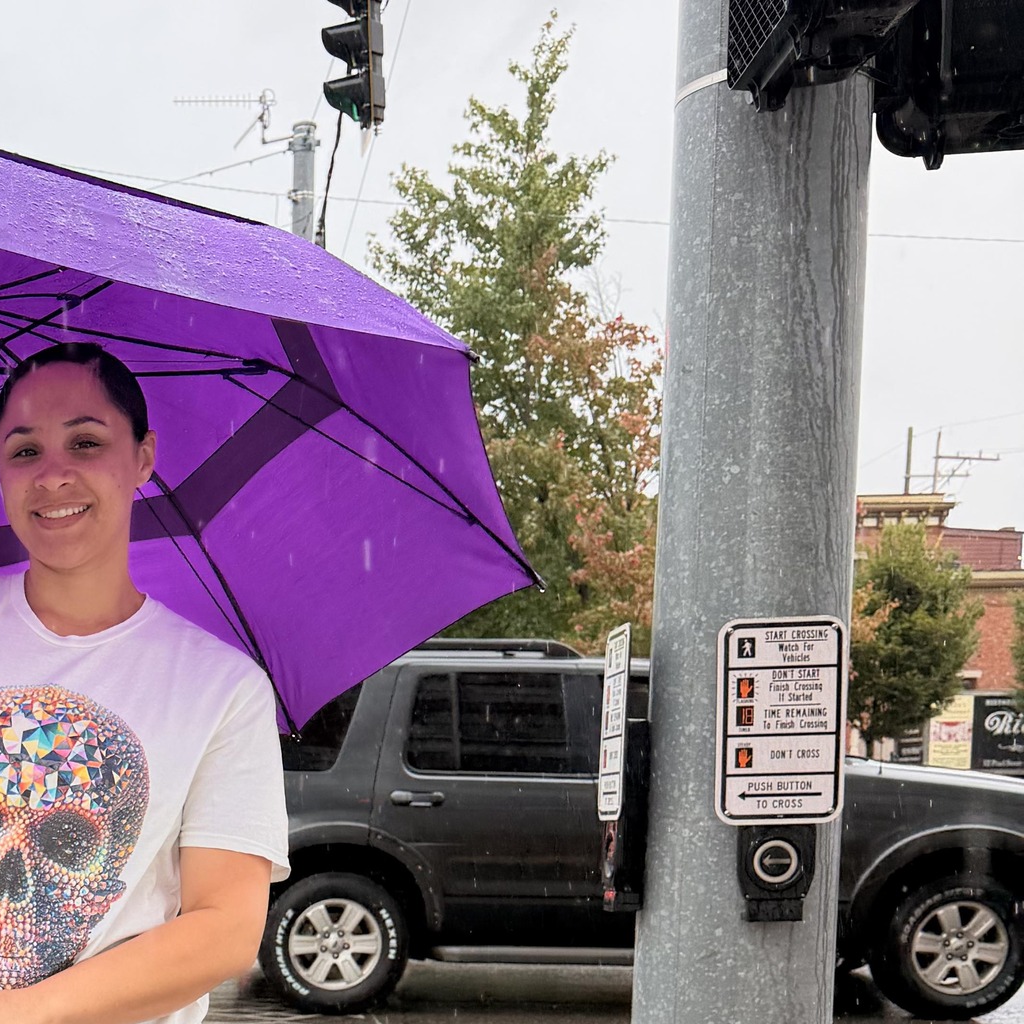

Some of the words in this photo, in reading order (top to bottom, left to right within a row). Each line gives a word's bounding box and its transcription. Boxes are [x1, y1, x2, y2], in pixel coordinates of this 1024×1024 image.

[765, 630, 787, 640] START
[791, 629, 828, 639] CROSSING
[778, 643, 799, 652] Watch
[803, 642, 814, 651] For
[782, 654, 810, 662] Vehicles
[772, 669, 794, 679] DON'T
[798, 669, 820, 678] START
[769, 682, 789, 691] Finish
[794, 682, 823, 692] Crossing
[779, 693, 785, 702] If
[788, 693, 813, 701] Started
[764, 709, 781, 718] TIME
[786, 708, 827, 717] REMAINING
[763, 720, 771, 729] To
[776, 720, 795, 729] Finish
[799, 720, 828, 730] Crossing
[770, 750, 793, 759] DON'T
[796, 749, 820, 759] CROSS
[747, 782, 773, 791] PUSH
[777, 781, 812, 791] BUTTON
[756, 800, 767, 809] TO
[772, 799, 803, 808] CROSS
[379, 908, 397, 960] NEXEN
